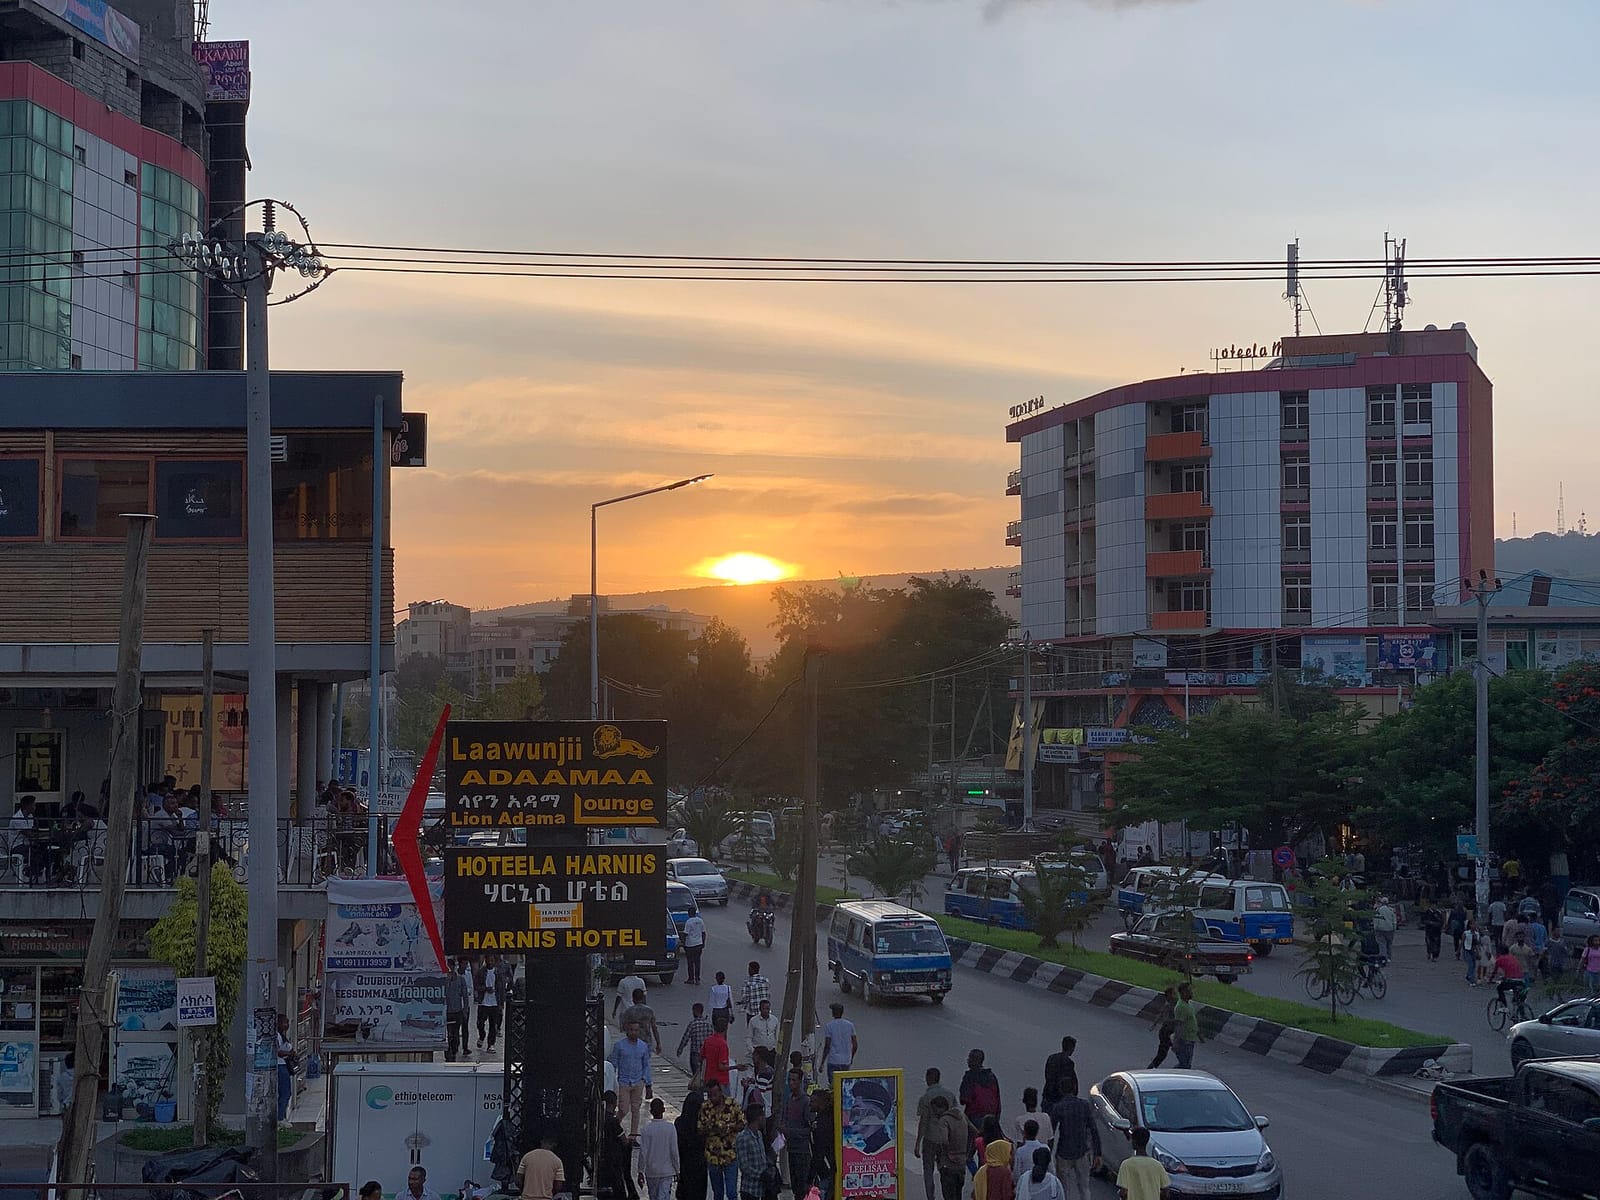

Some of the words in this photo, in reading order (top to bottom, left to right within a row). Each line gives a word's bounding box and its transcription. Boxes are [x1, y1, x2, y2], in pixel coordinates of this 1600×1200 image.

[451, 736, 582, 767] Laawunjii
[459, 769, 654, 785] ADAAMAA
[508, 794, 560, 809] አዳማ
[574, 792, 660, 825] Lounge
[451, 812, 493, 826] Lion
[498, 811, 566, 826] Adama
[457, 855, 557, 877] HOTEELA
[565, 853, 656, 875] HARNIIS
[567, 880, 629, 902] ሆቴል
[11, 940, 43, 951] Hema
[463, 930, 556, 950] HARNIS
[565, 928, 648, 948] HOTEL
